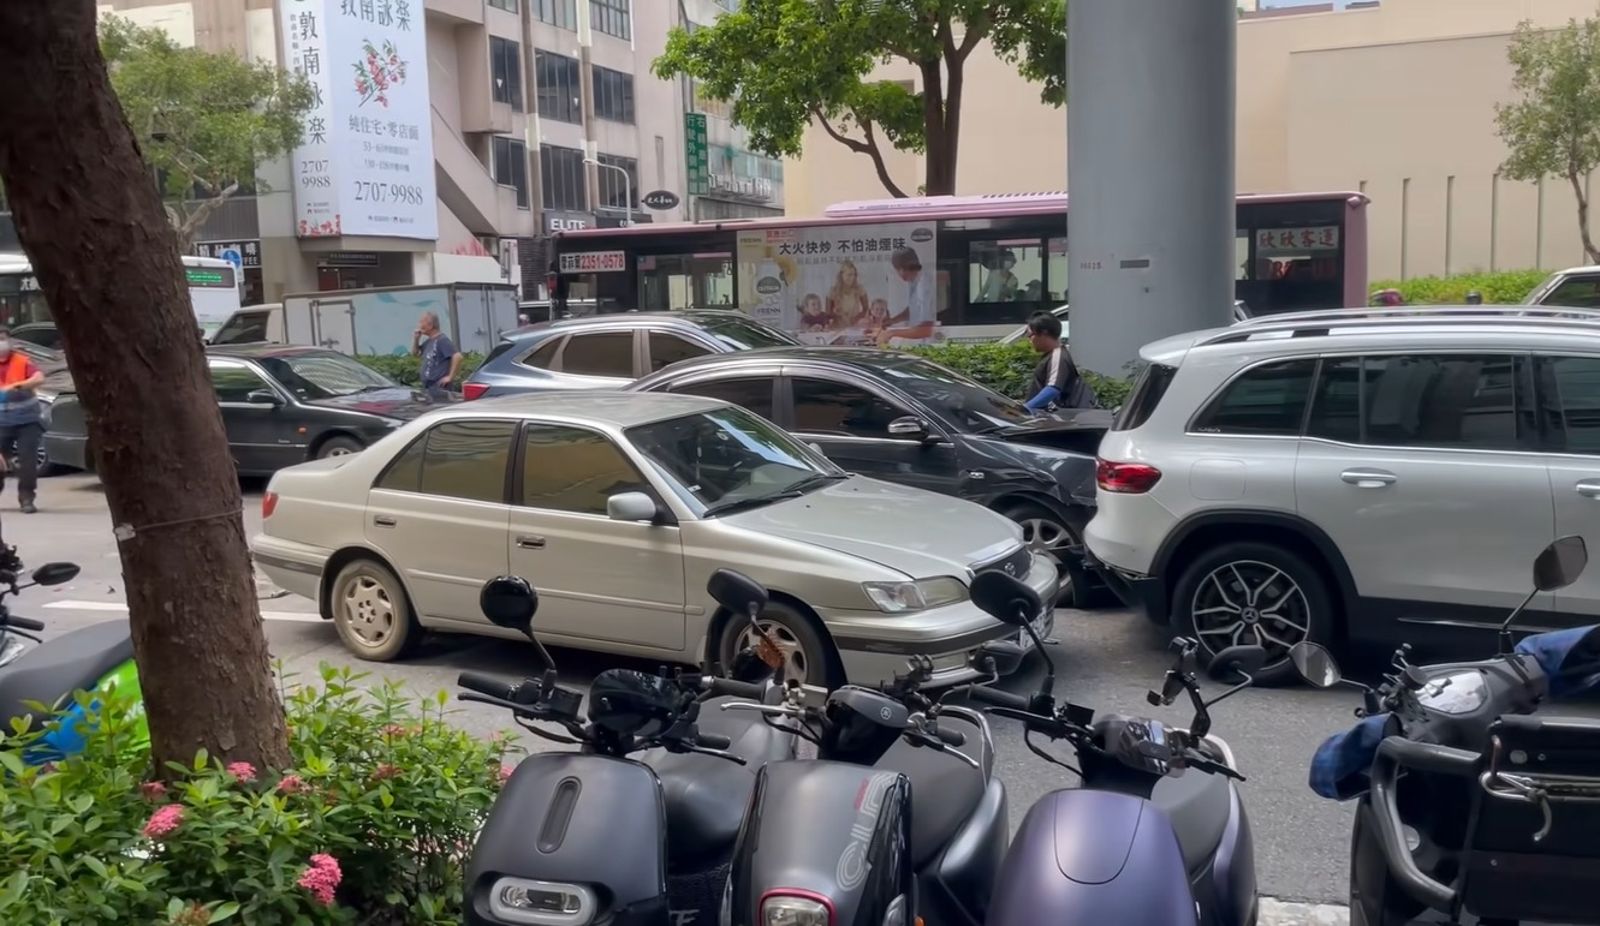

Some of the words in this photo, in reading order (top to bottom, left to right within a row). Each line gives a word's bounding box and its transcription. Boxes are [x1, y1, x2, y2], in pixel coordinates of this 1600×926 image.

[301, 160, 329, 174] 2707
[302, 176, 331, 189] 9988
[551, 218, 585, 231] ELITE
[1260, 228, 1335, 249] 欣欣客運
[779, 241, 832, 256] 大火快炒
[837, 237, 907, 254] 不怕油煙味
